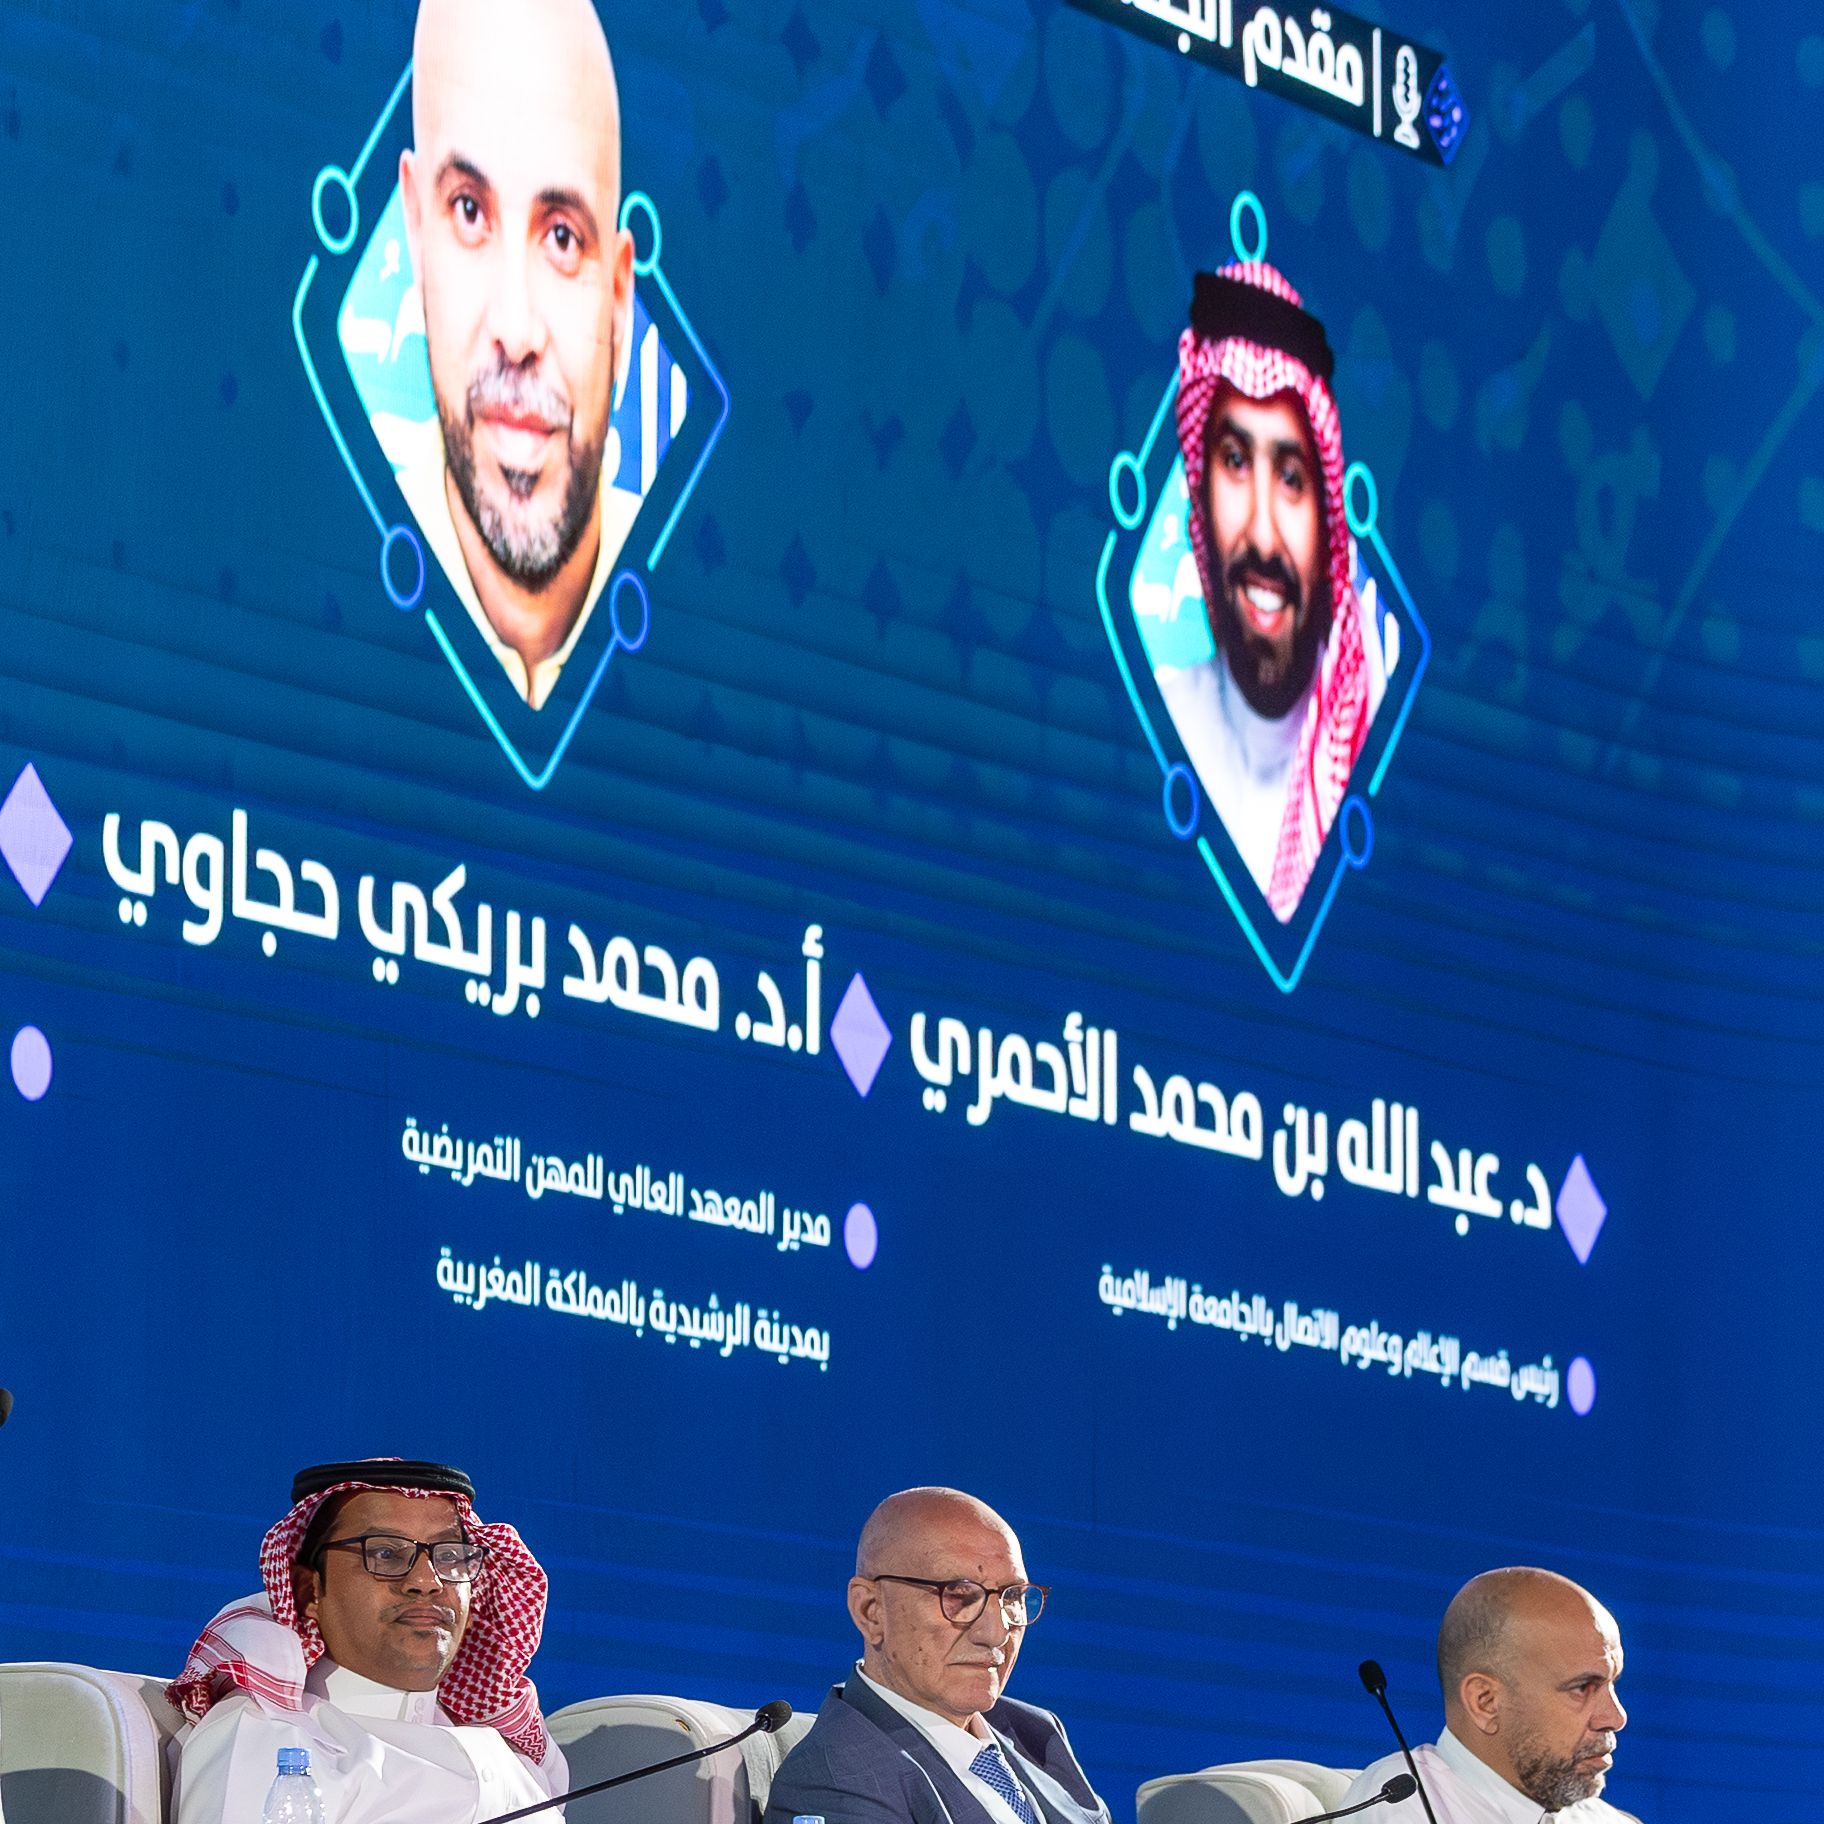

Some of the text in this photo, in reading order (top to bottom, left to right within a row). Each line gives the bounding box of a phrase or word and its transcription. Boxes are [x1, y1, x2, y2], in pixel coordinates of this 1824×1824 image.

[1242, 7, 1363, 106] مقدم
[103, 809, 339, 956] حجاوي
[358, 864, 545, 1017] بريكي
[563, 925, 719, 1030] محمد
[911, 1012, 1117, 1125] الأحمري
[1130, 1066, 1263, 1160] محمد
[403, 1118, 830, 1251] مدير المعهد العالي للمهن التمريضية
[1273, 1104, 1327, 1200] بن
[1337, 1099, 1418, 1197] الله
[1428, 1141, 1502, 1235] عبد
[437, 1248, 829, 1370] بمدينة الرشيدية بالمملكة المغربية
[1099, 1266, 1186, 1330] الإسلامية
